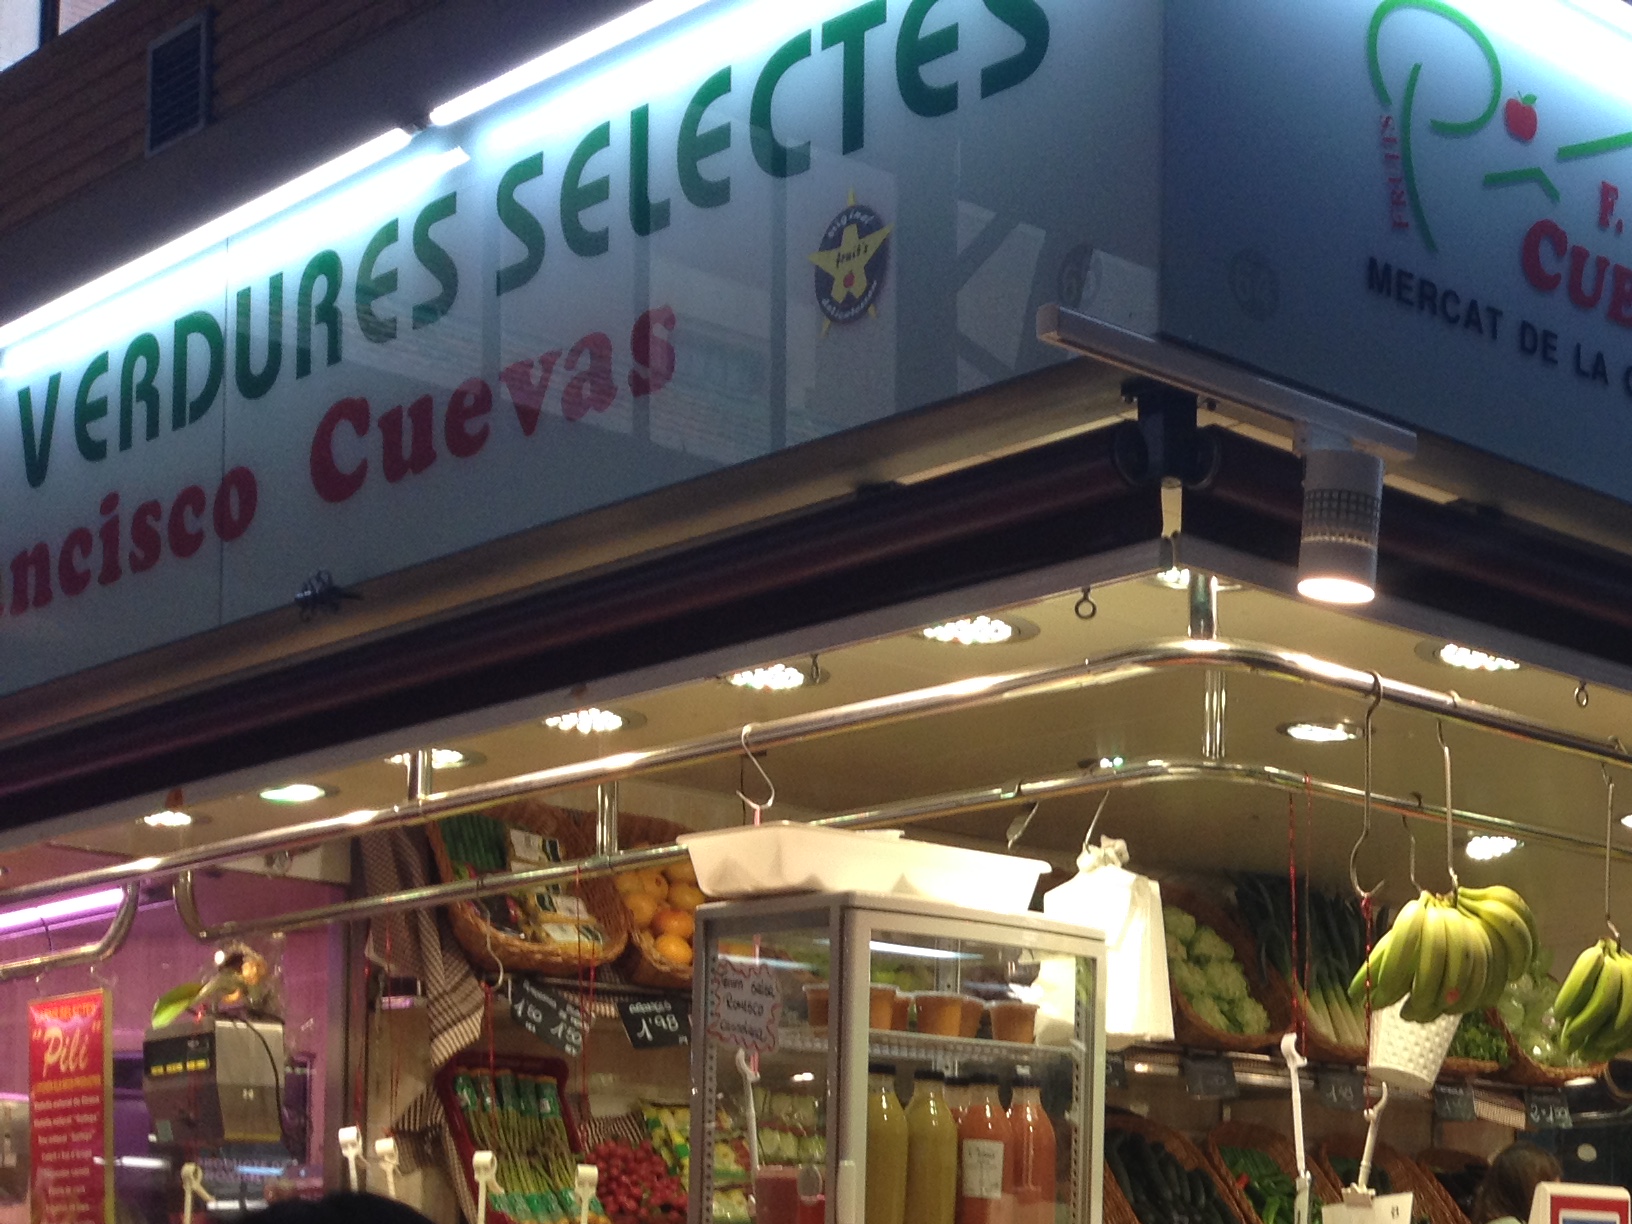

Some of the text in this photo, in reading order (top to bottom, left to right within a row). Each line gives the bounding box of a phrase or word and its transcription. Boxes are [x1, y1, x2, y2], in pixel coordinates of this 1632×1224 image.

[17, 0, 1050, 489] VERDURES SELECTES
[1598, 181, 1624, 235] F.
[1367, 256, 1503, 342] MERCAT
[1519, 319, 1559, 366] DE
[1574, 343, 1609, 387] LA
[0, 305, 677, 617] ncisco Cuevas
